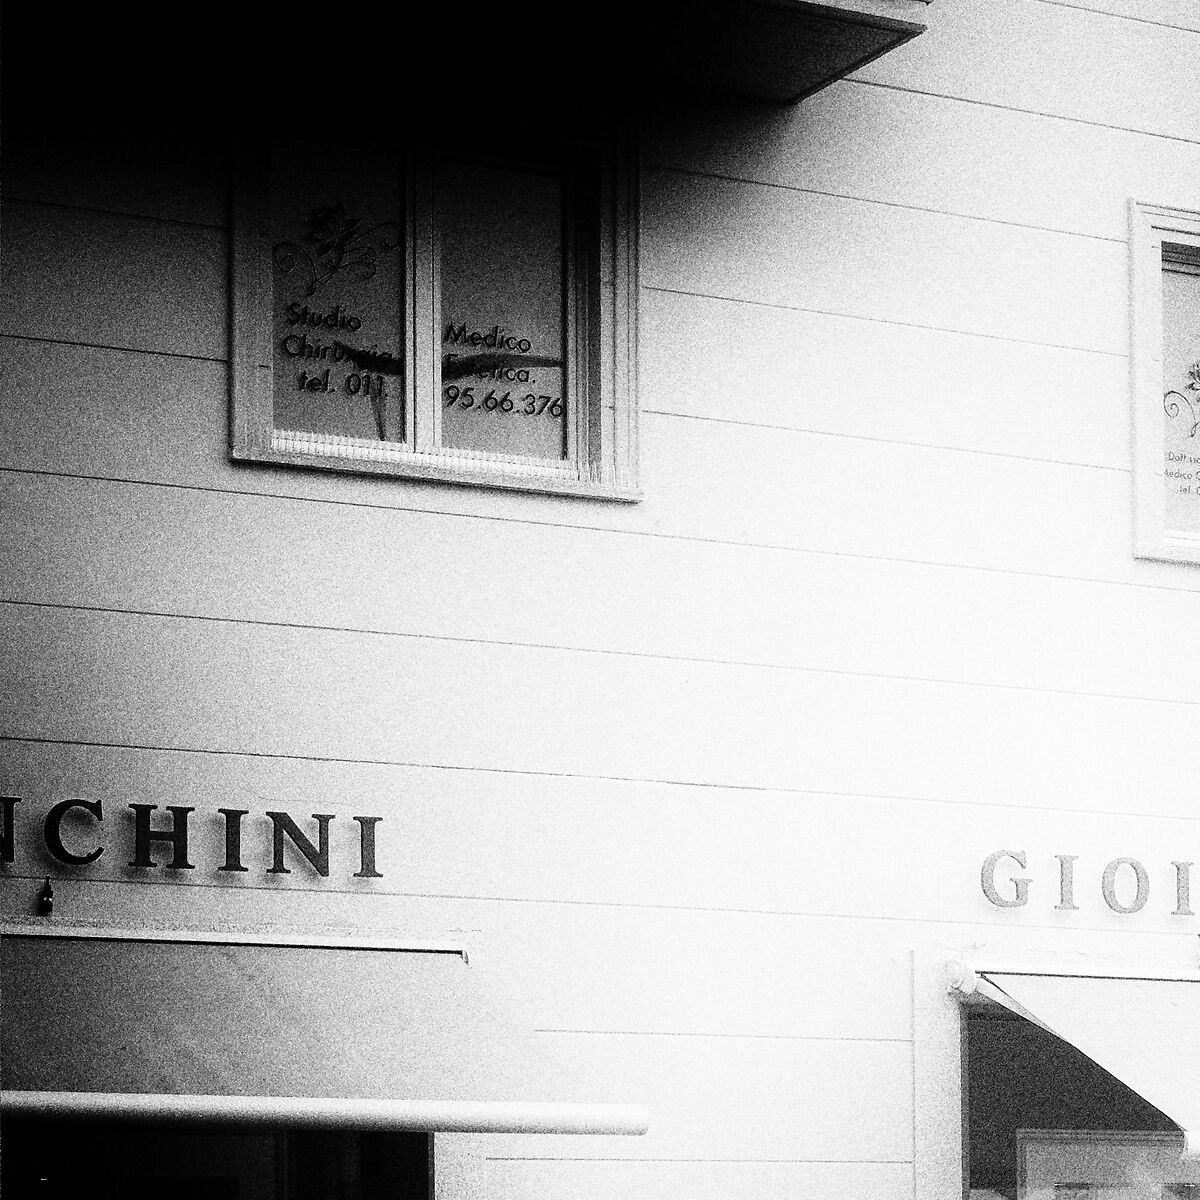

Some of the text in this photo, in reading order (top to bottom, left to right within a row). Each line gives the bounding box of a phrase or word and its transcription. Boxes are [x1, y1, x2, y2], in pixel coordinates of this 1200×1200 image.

[281, 333, 393, 368] Chiruia
[286, 300, 532, 353] Studio Medico
[298, 367, 335, 394] tel.
[445, 385, 564, 417] 95.66.376
